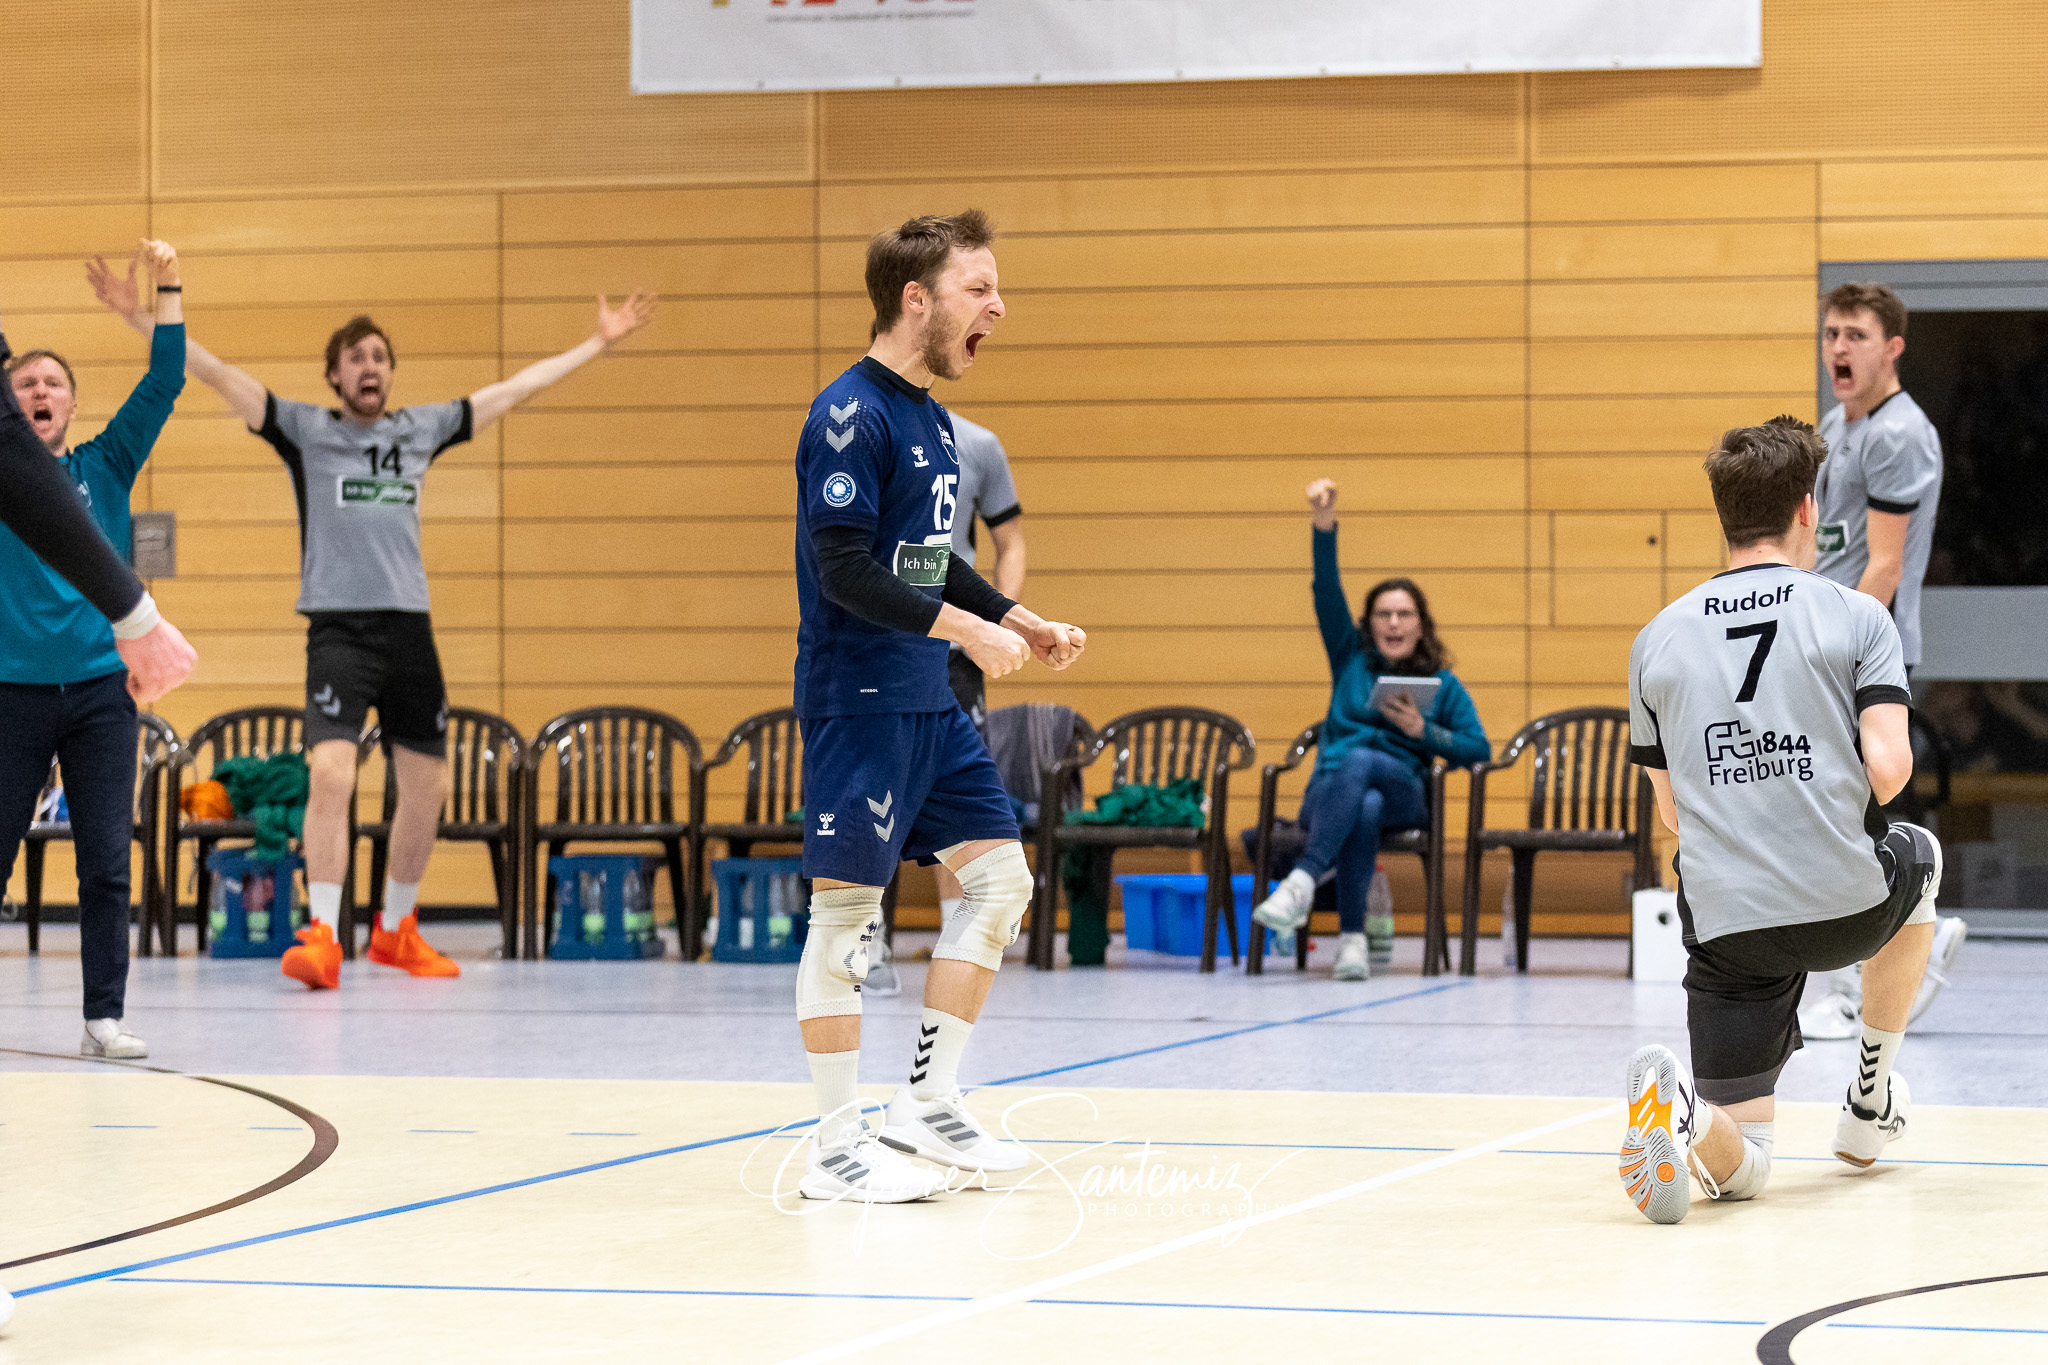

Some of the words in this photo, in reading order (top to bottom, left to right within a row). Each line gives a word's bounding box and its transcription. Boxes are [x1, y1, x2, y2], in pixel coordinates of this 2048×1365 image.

[363, 444, 404, 477] 14
[931, 474, 957, 531] 15
[903, 557, 920, 570] Ich
[924, 557, 937, 570] bin
[1704, 584, 1794, 616] Rudolf
[1726, 619, 1778, 703] 7
[1708, 756, 1814, 786] Freiburg
